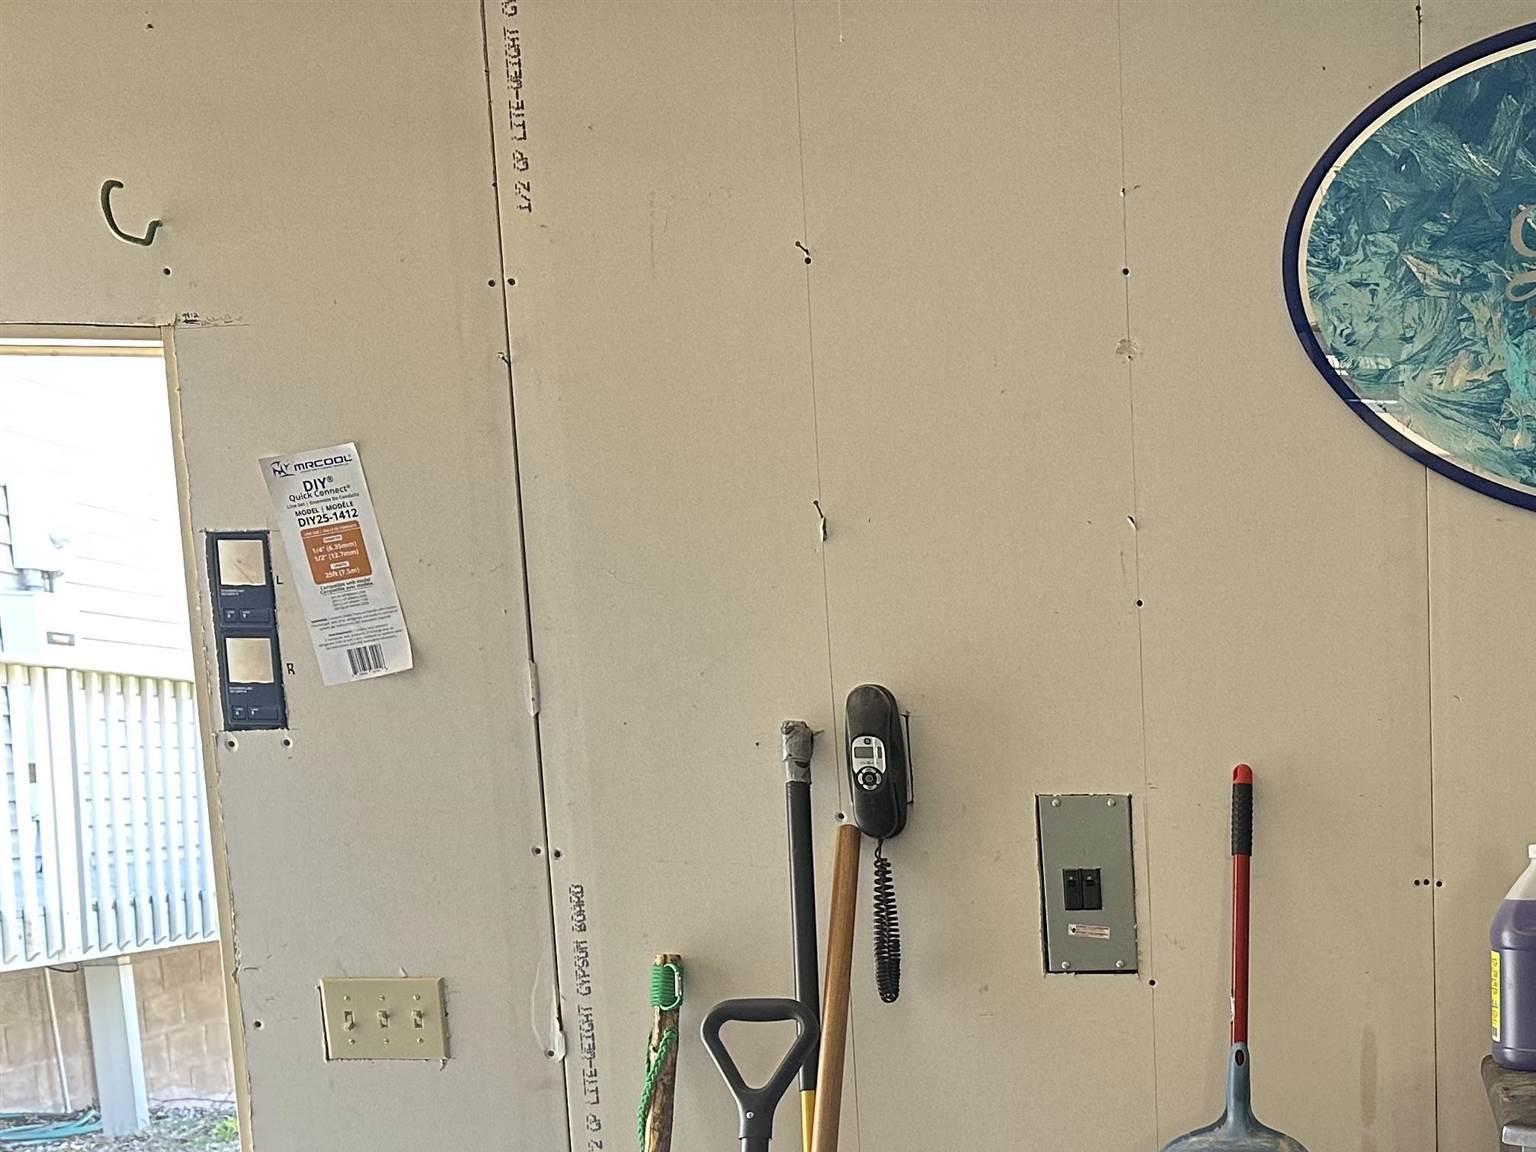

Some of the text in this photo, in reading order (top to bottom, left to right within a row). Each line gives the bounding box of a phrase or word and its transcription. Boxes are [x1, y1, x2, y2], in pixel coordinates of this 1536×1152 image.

[503, 26, 528, 141] LITE-WEIGHT
[288, 490, 313, 502] Quick
[295, 507, 319, 517] MODEL
[298, 508, 358, 527] DIY25-1412
[286, 662, 296, 676] R
